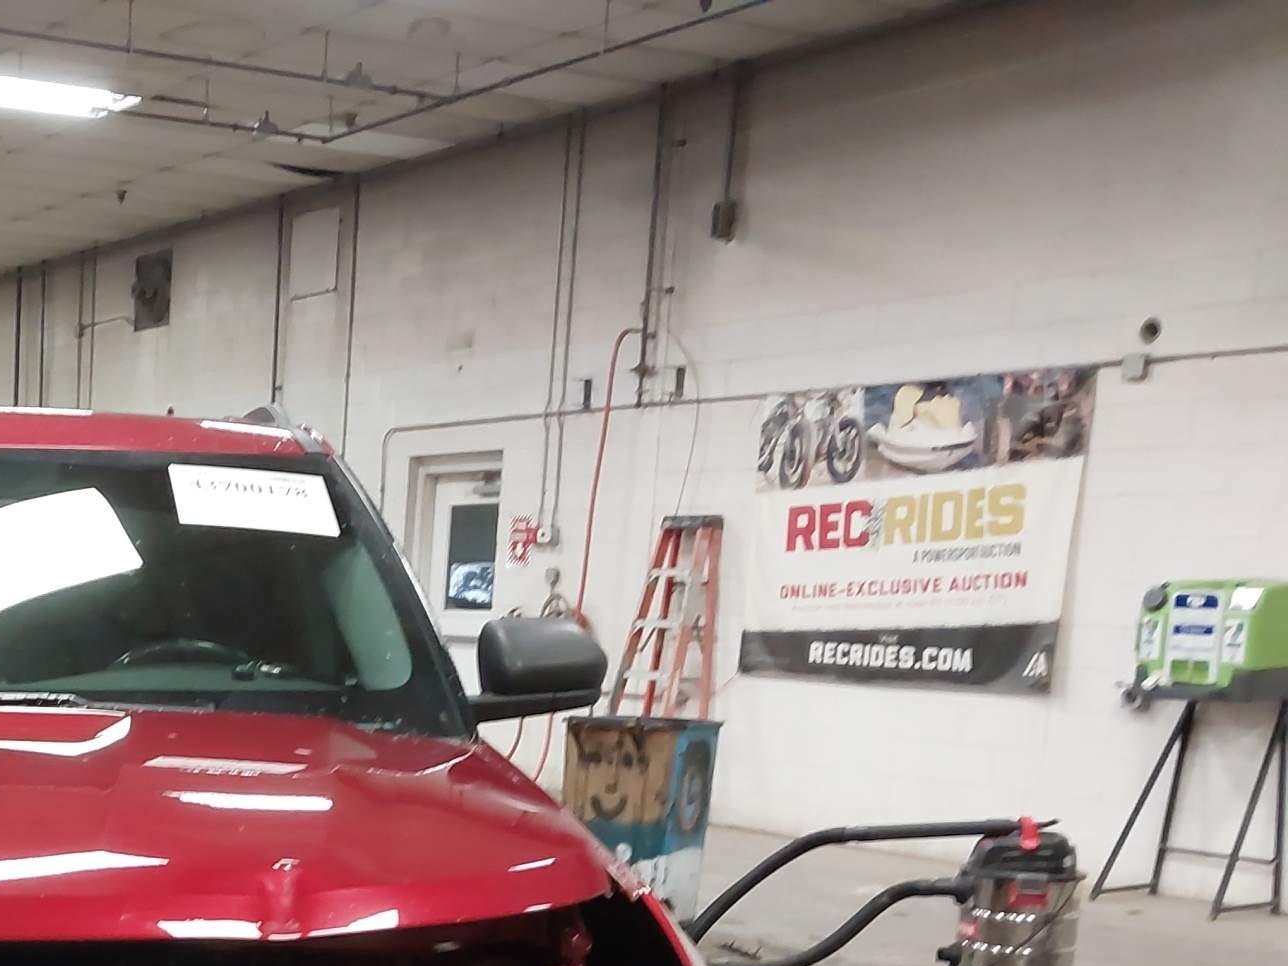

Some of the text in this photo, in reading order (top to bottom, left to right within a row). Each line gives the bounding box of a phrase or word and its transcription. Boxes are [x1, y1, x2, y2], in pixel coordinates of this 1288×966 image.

[786, 484, 1027, 552] REC RIDES
[779, 571, 1028, 600] ONLINE-EXCLUSIVE AUCTION
[808, 640, 973, 673] RECRIDES.COM
